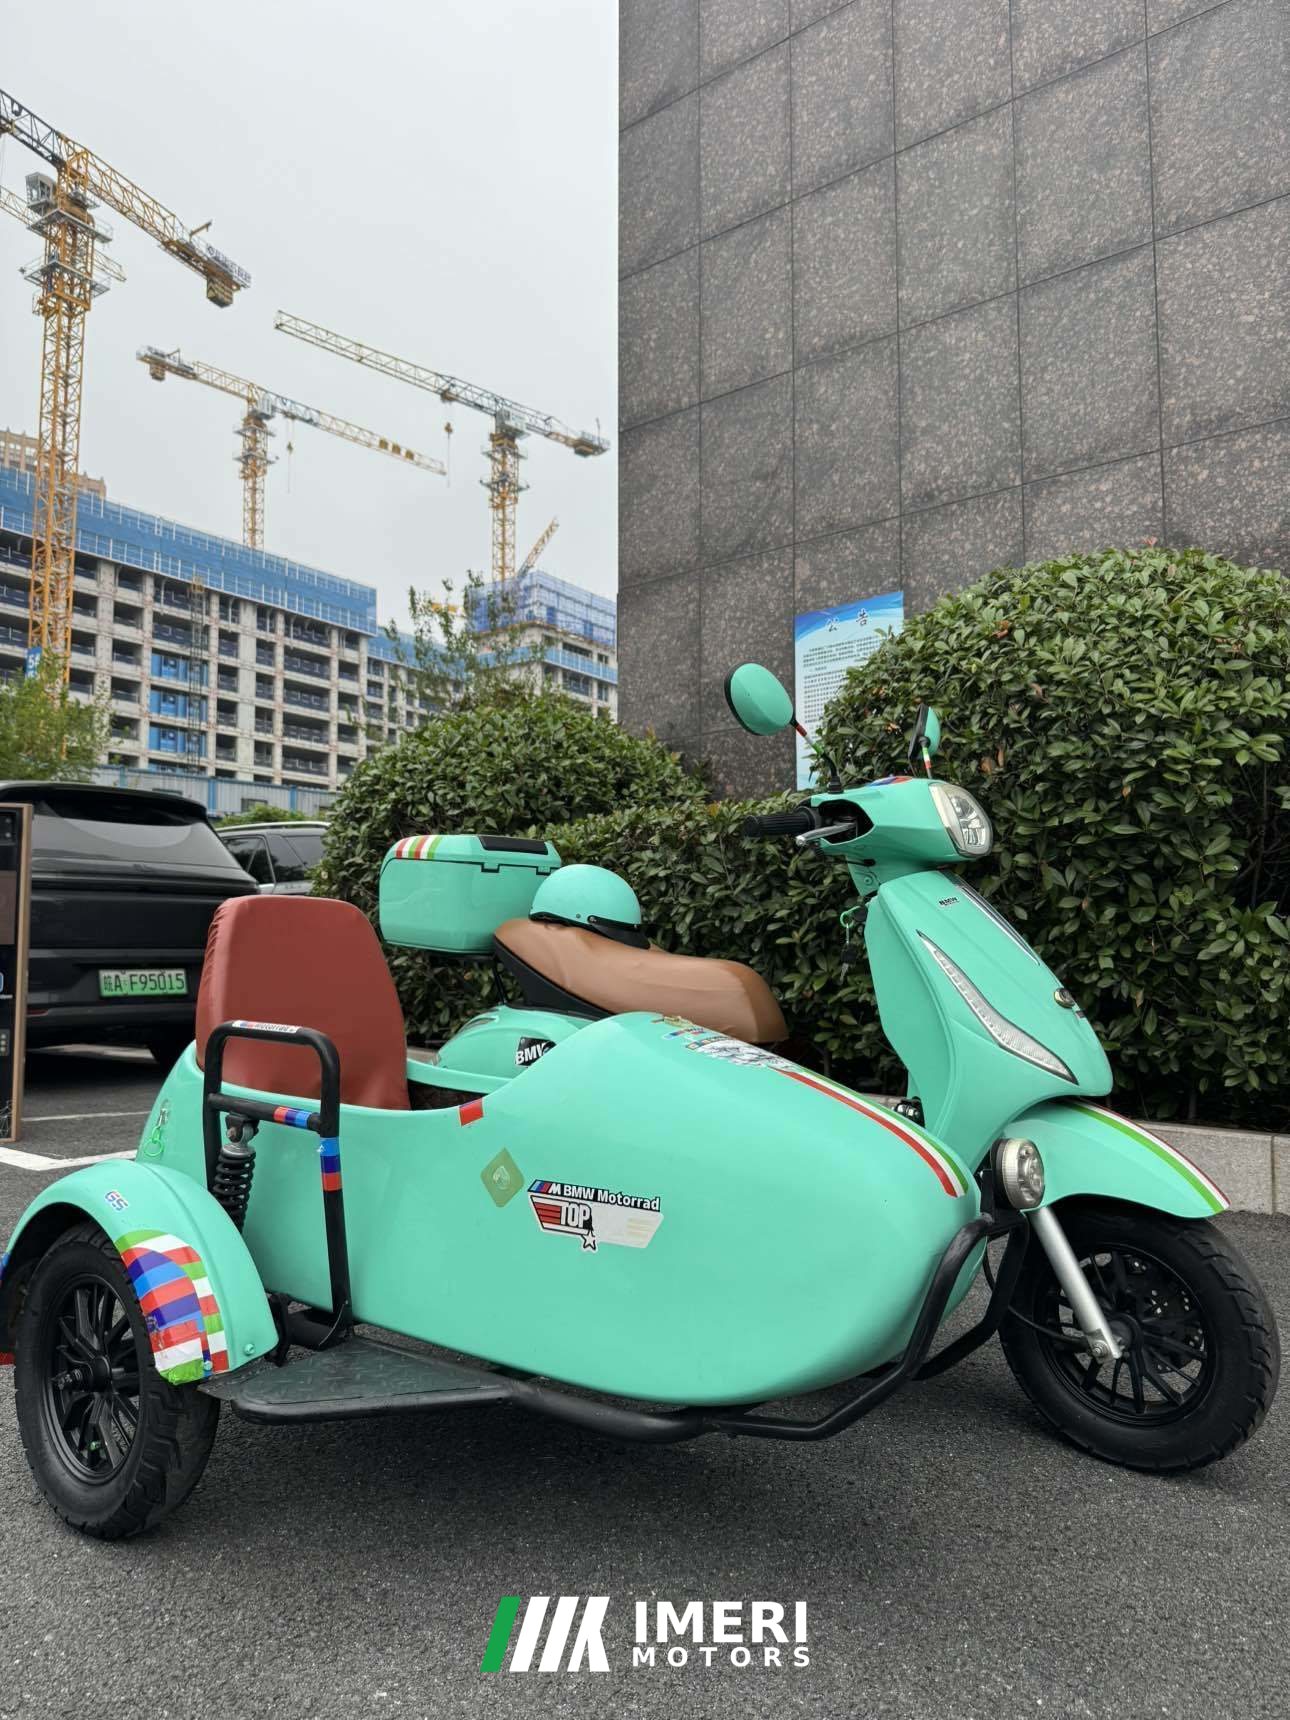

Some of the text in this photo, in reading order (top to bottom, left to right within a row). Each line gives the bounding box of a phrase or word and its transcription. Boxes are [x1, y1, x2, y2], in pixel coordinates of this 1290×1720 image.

[563, 1184, 595, 1200] BMW
[597, 1189, 660, 1210] Motorrad
[561, 1203, 591, 1228] TOP
